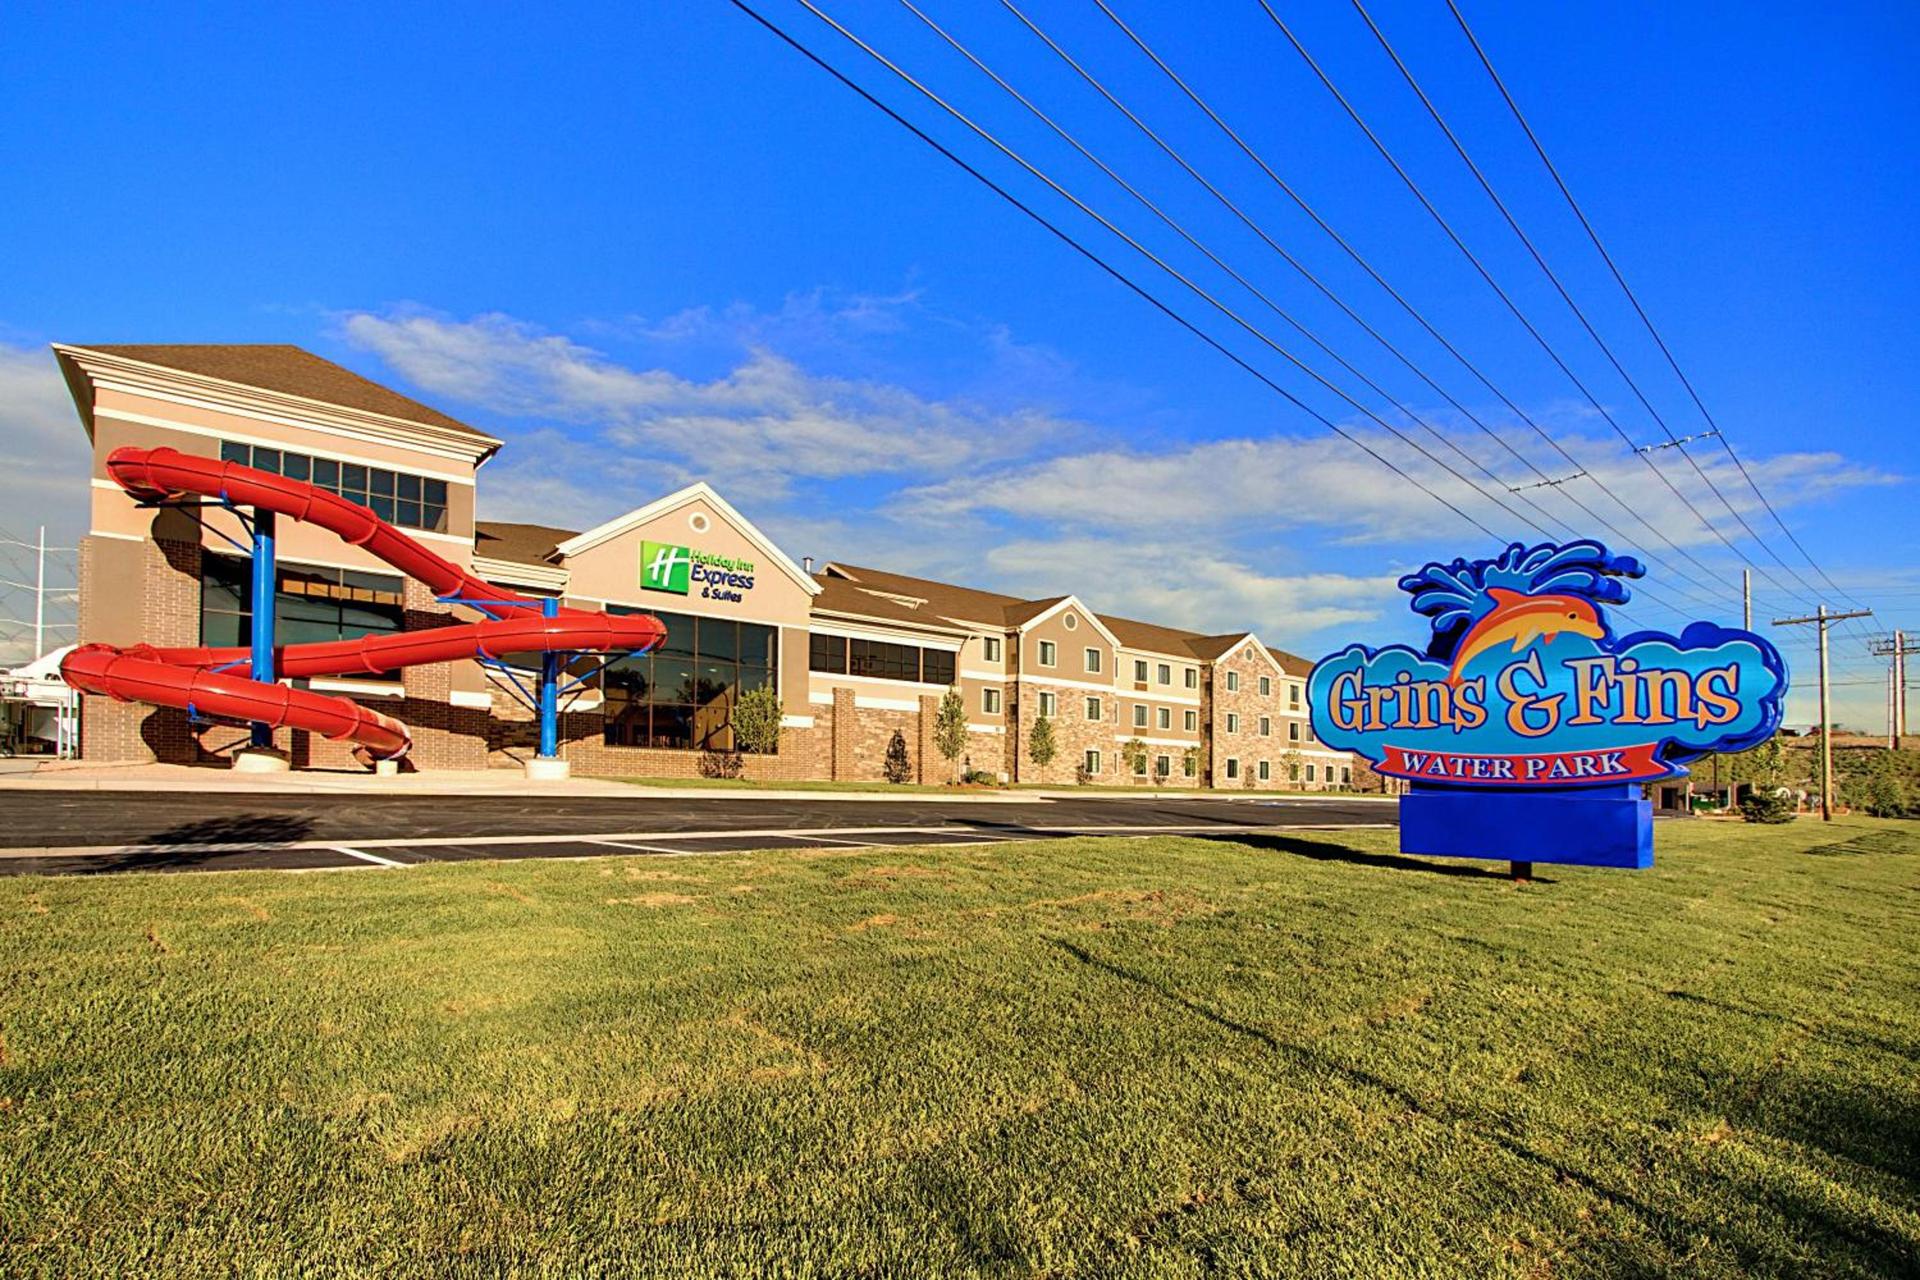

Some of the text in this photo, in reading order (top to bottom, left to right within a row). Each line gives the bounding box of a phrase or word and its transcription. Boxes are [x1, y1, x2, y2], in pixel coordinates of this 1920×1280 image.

[690, 551, 754, 573] Holiday Inn
[691, 563, 755, 589] Express
[701, 586, 742, 603] & Suites
[1328, 647, 1743, 739] Grins & Fins
[1400, 751, 1632, 781] WATER PARK
